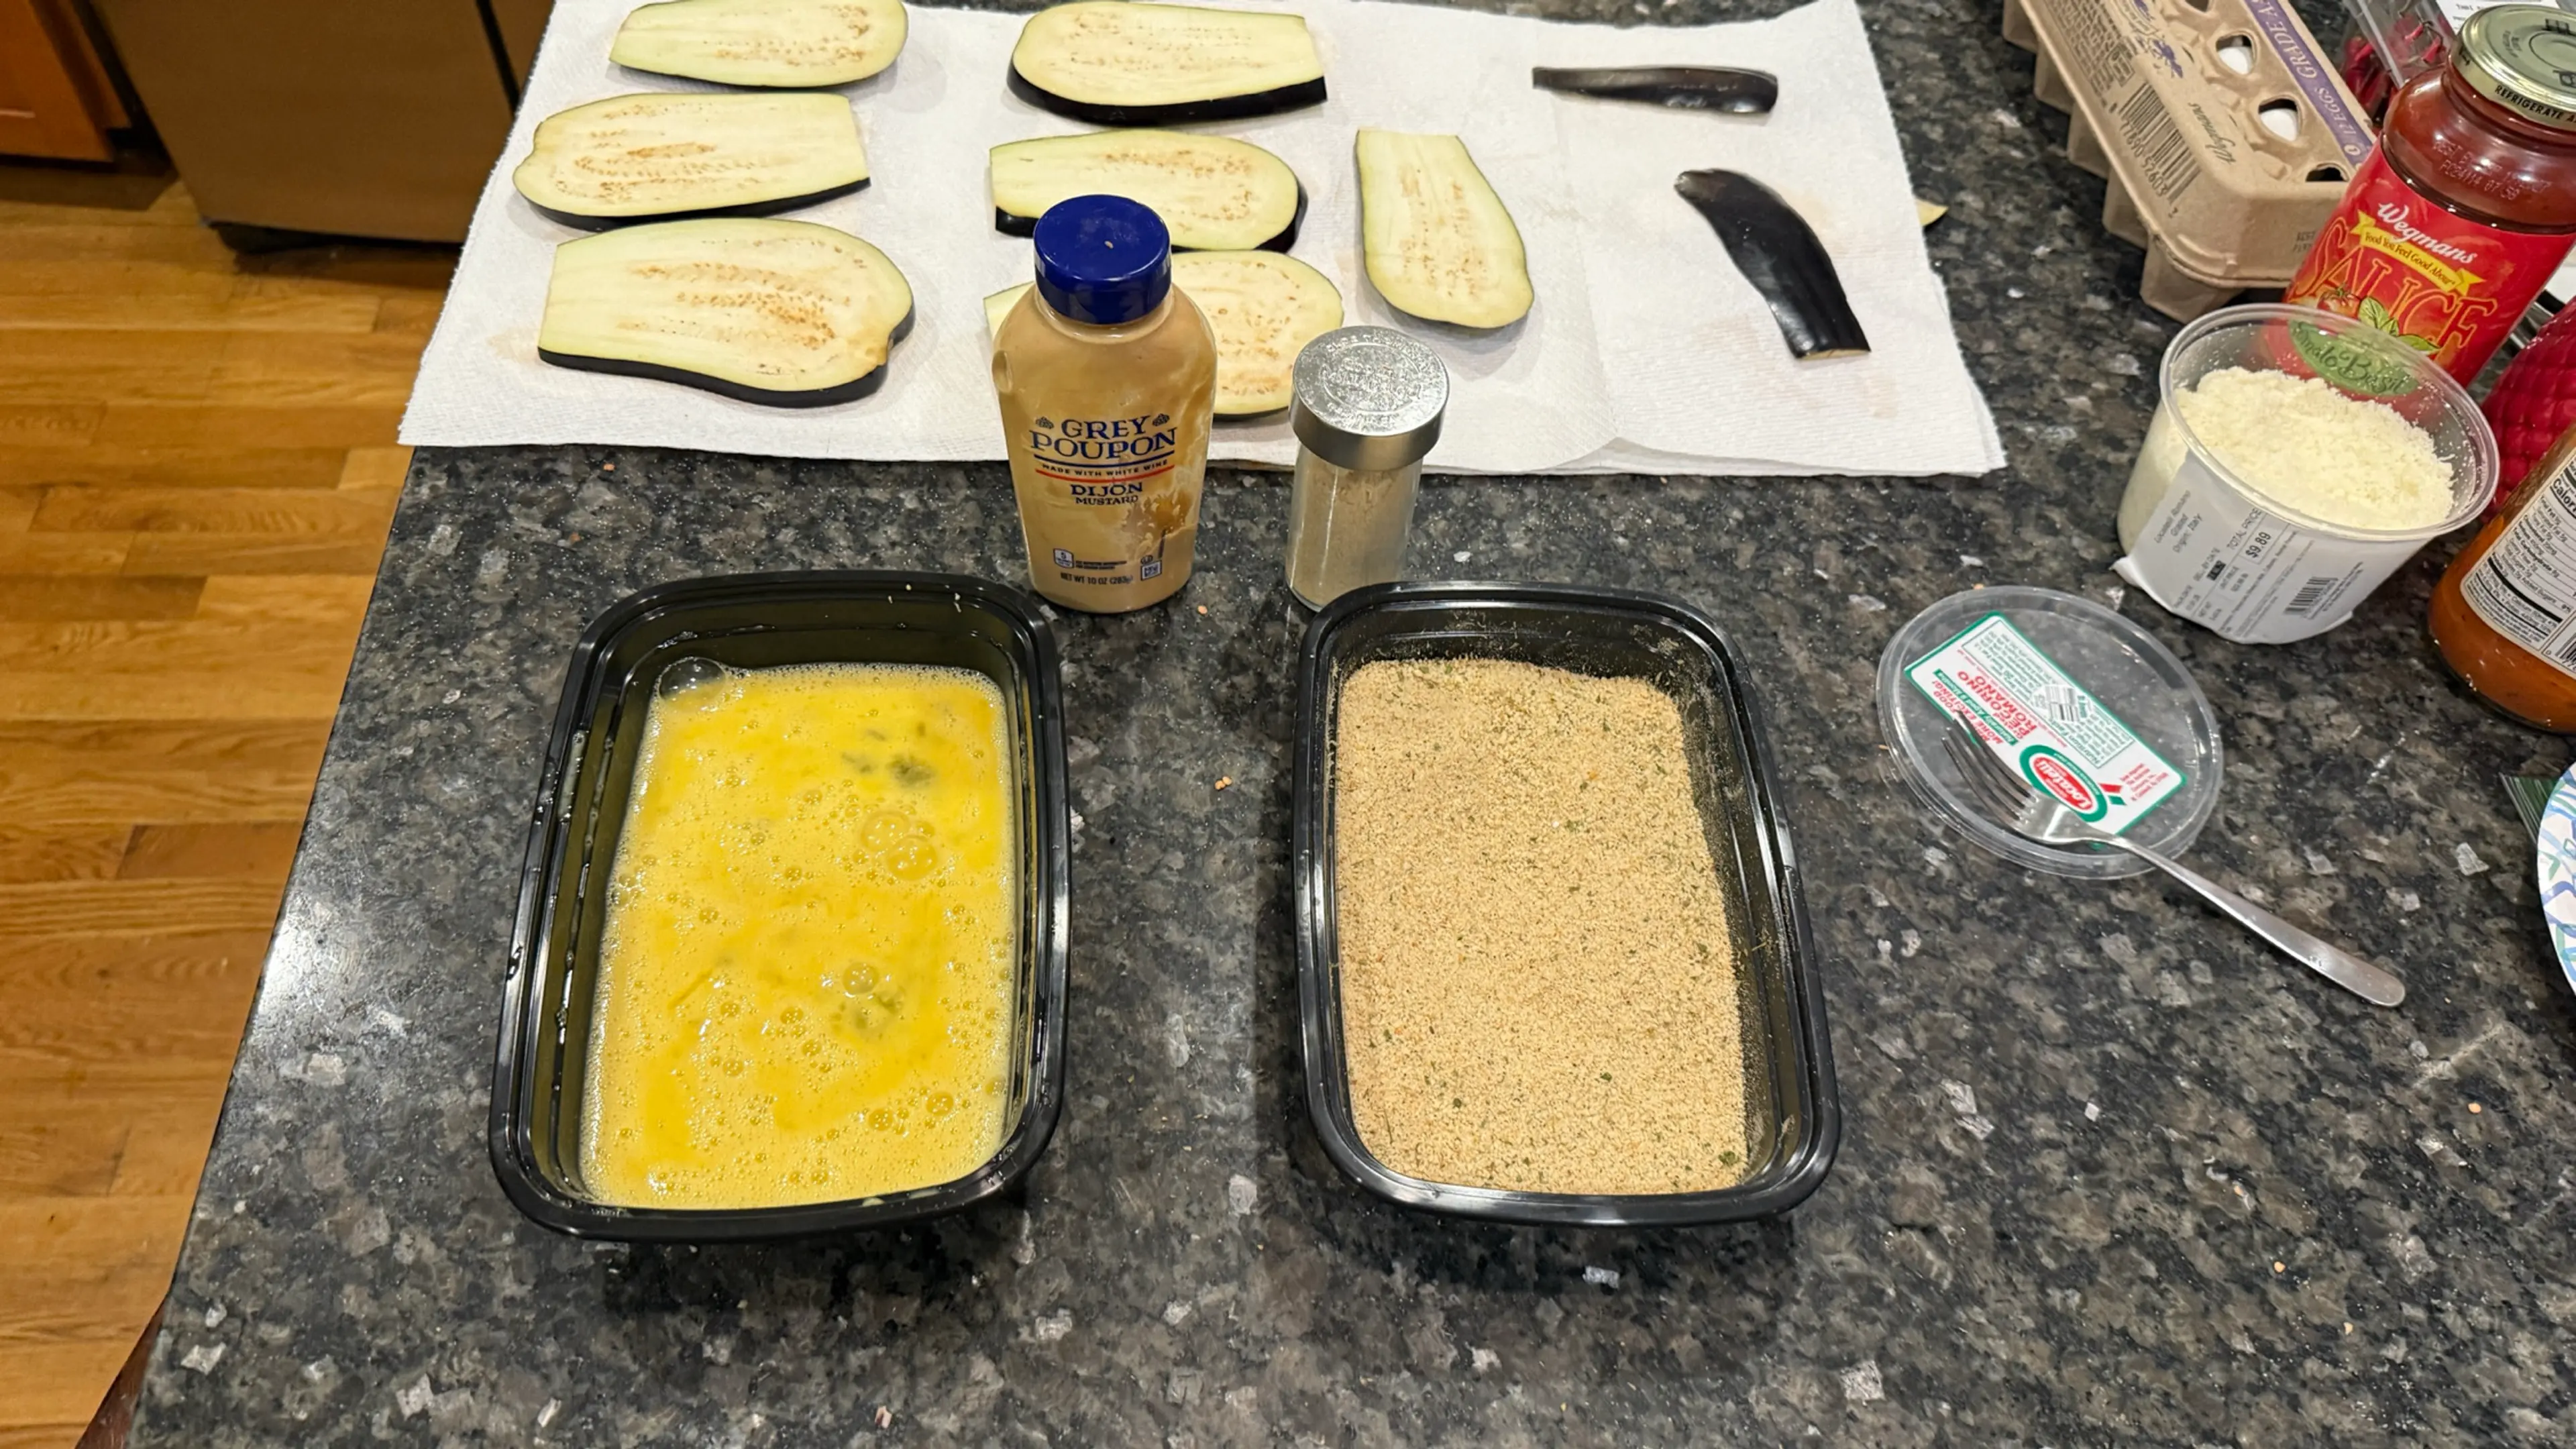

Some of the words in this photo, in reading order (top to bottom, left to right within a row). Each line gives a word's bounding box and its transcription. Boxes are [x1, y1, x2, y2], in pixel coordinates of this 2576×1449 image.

[2267, 21, 2317, 78] GRADE
[2315, 87, 2347, 123] EGGS
[2494, 85, 2565, 120] REFRIGERATE
[2188, 102, 2237, 165] Wegmans
[2119, 121, 2145, 158] 77890
[2141, 156, 2169, 197] 52603
[2365, 231, 2381, 245] Food
[2382, 239, 2396, 252] You
[2396, 244, 2412, 258] Feel
[2410, 248, 2432, 270] Good
[2377, 203, 2478, 264] Wegmans
[2338, 350, 2409, 396] Basil
[1029, 427, 1177, 460] POUPON
[1061, 415, 1151, 439] GREY
[1042, 464, 1071, 475] MADE
[1106, 468, 1139, 477] WHITE
[1143, 459, 1168, 472] WINE
[1070, 482, 1143, 497] DIJON
[1075, 495, 1138, 506] MUSTARD
[2226, 526, 2247, 551] TOTAL
[2240, 505, 2263, 531] PRICE
[2245, 529, 2272, 561] $9.89
[2518, 539, 2553, 574] Carbohydrate
[1060, 572, 1072, 581] NET
[1074, 576, 1085, 584] WT
[1087, 576, 1097, 585] 10
[1098, 577, 1108, 585] OZ
[1930, 678, 1978, 722] EXCITING!
[1931, 689, 1958, 714] FOOD
[1955, 668, 2031, 737] PECORINO
[1973, 673, 2037, 732] ROMANO
[1976, 720, 2003, 745] MORE
[1992, 710, 2024, 741] Grated
[2035, 758, 2092, 811] Locatelli
